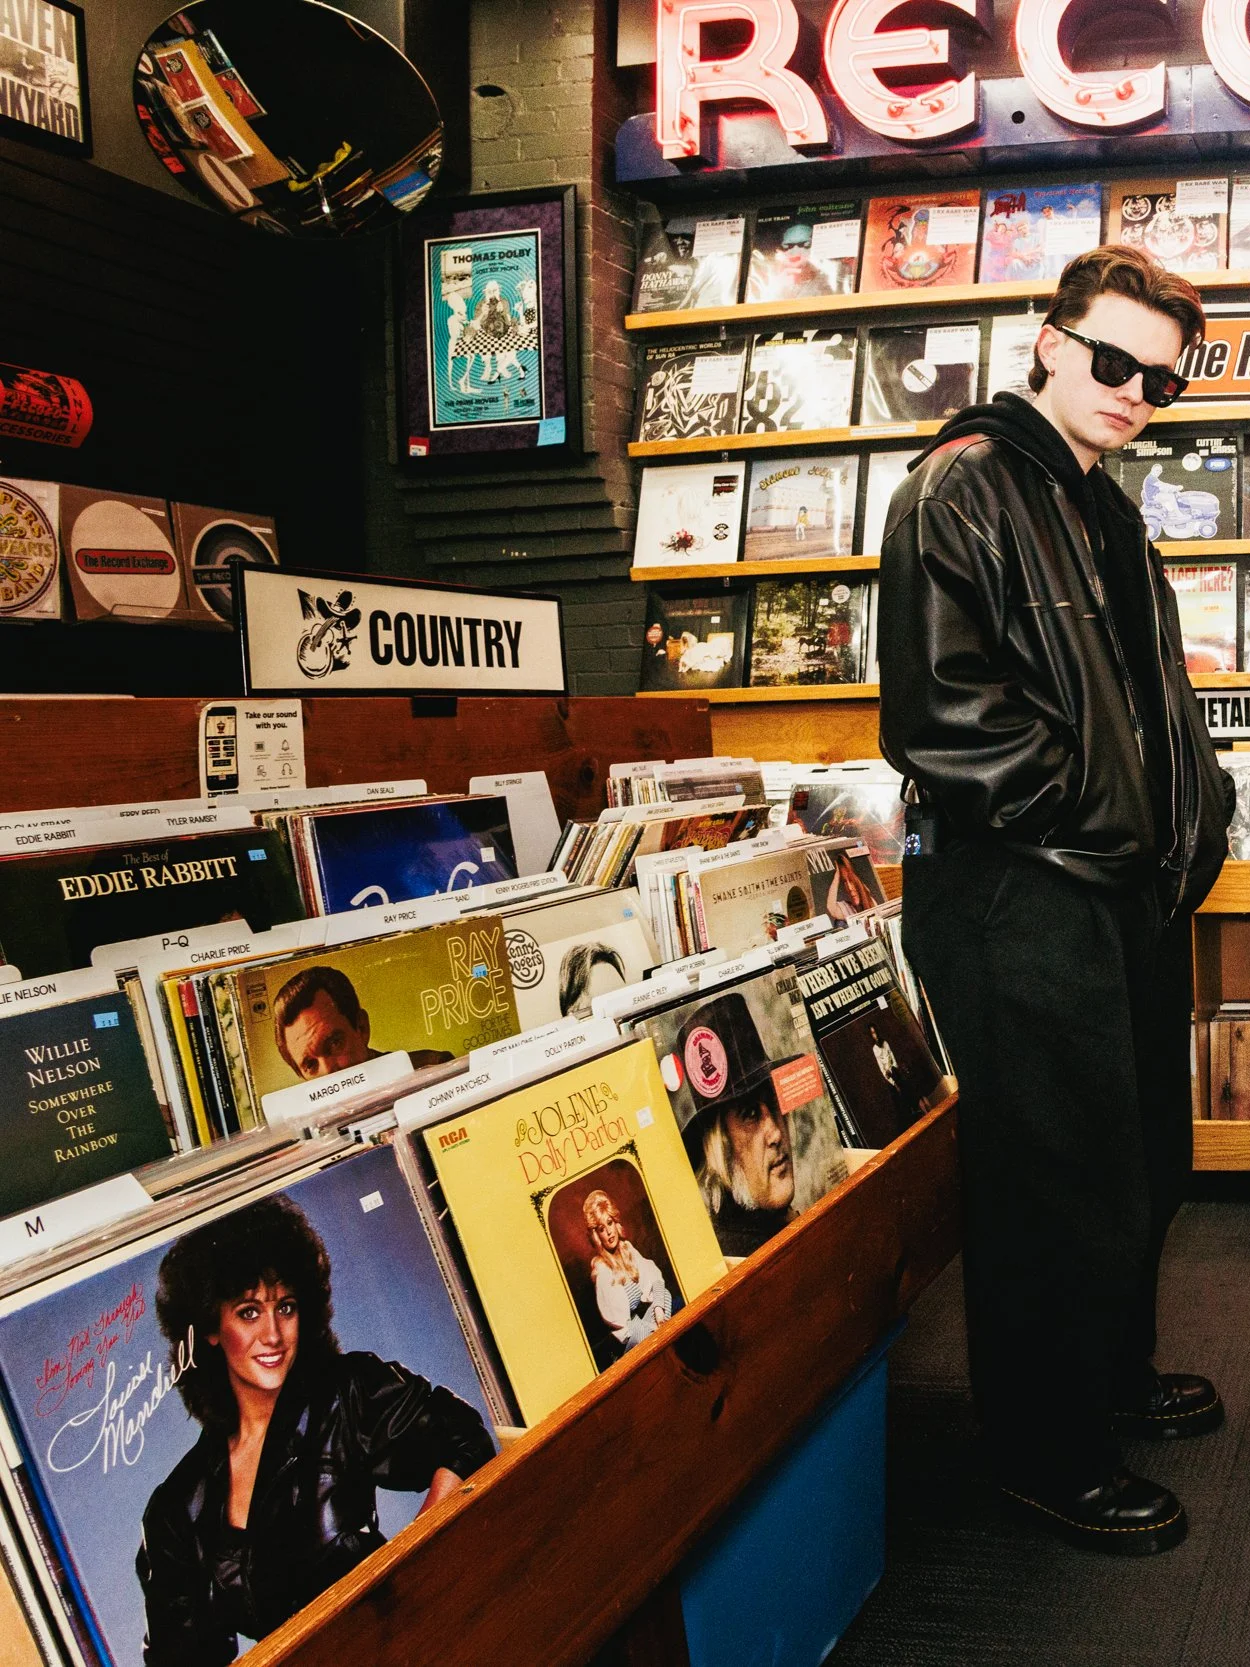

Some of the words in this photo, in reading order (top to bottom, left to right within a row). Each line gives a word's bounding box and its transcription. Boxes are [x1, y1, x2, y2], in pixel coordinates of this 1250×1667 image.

[453, 252, 498, 265] THOMAS
[500, 248, 532, 260] DOLBY
[1176, 337, 1227, 380] he
[84, 555, 99, 567] The
[100, 556, 131, 569] Record
[131, 557, 169, 571] Exchange
[368, 609, 523, 669] COUNTRY
[245, 711, 261, 719] Take
[276, 710, 298, 719] sound
[255, 721, 270, 730] with
[272, 722, 288, 731] you.
[366, 787, 379, 796] DAN
[379, 786, 395, 796] SEALS
[166, 817, 188, 827] TYLER
[188, 813, 218, 825] RAMSEY
[15, 833, 43, 846] EDDIE
[44, 829, 76, 842] RABBITT
[123, 852, 141, 867] The
[141, 852, 161, 865] Best
[161, 850, 172, 863] of
[58, 869, 139, 902] EDDIE
[139, 856, 238, 889] RABBITT
[383, 913, 399, 924] RAY
[399, 909, 417, 921] PRICE
[161, 934, 190, 951] P-Q
[190, 947, 227, 964] CHARLIE
[227, 943, 251, 959] PRIDE
[446, 926, 501, 982] RAY
[797, 962, 841, 999] WHERE
[834, 953, 862, 980] I'VE
[15, 983, 57, 1003] NELSON
[420, 970, 510, 1037] PRICE
[809, 996, 835, 1020] ISN'T
[829, 982, 863, 1009] WHERE
[856, 976, 874, 996] I'M
[868, 966, 893, 989] GOING
[24, 1037, 92, 1066] WILLIE
[544, 1043, 564, 1058] DOLLY
[564, 1034, 587, 1052] PARTON
[27, 1056, 102, 1089] NELSON
[28, 1080, 115, 1115] SOMEWHERE
[309, 1080, 340, 1101] MARGO
[340, 1072, 366, 1091] PRICE
[427, 1086, 456, 1109] JOHNNY
[456, 1072, 492, 1099] PAYCHECK
[56, 1104, 97, 1125] OVER
[526, 1084, 608, 1146] JOLENE
[65, 1122, 97, 1141] THE
[438, 1126, 469, 1146] RCA
[54, 1133, 119, 1164] RAINBOW
[518, 1138, 568, 1187] Dolly
[575, 1113, 635, 1156] Parton
[24, 1215, 46, 1239] M
